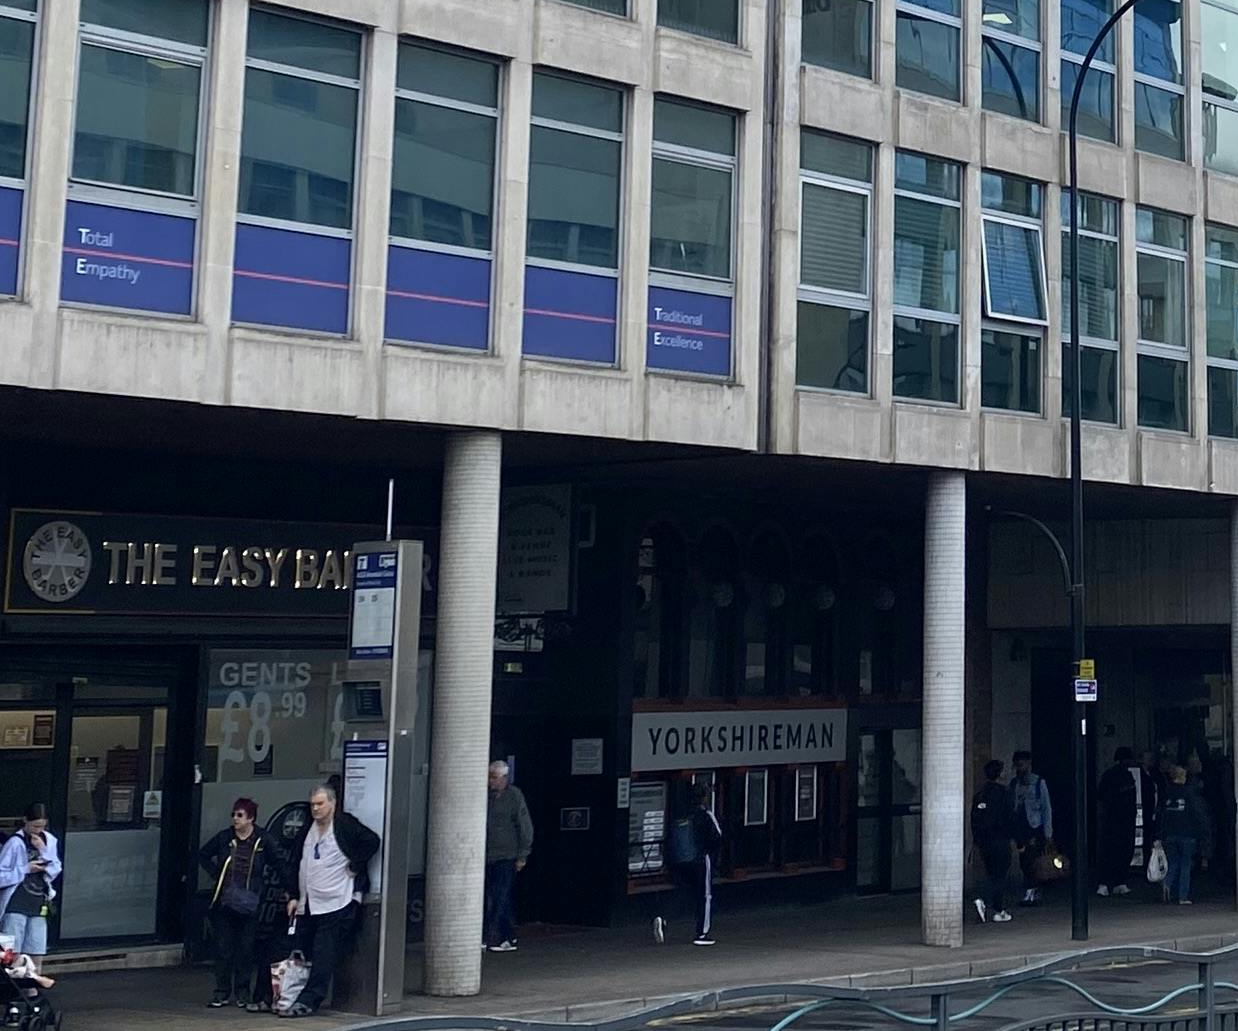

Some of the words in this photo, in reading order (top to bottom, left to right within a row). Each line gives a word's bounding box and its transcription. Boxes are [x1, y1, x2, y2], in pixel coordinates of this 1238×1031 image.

[78, 228, 114, 247] Total
[76, 257, 140, 284] Empathy
[654, 307, 704, 326] Traditional
[654, 331, 704, 350] Excellence
[31, 528, 54, 559] THE
[56, 526, 88, 559] EASY
[103, 541, 178, 585] THE
[191, 545, 288, 587] EASY
[31, 568, 86, 597] BARBER
[219, 662, 312, 687] GENTS
[648, 722, 835, 756] YORKSHIREMAN
